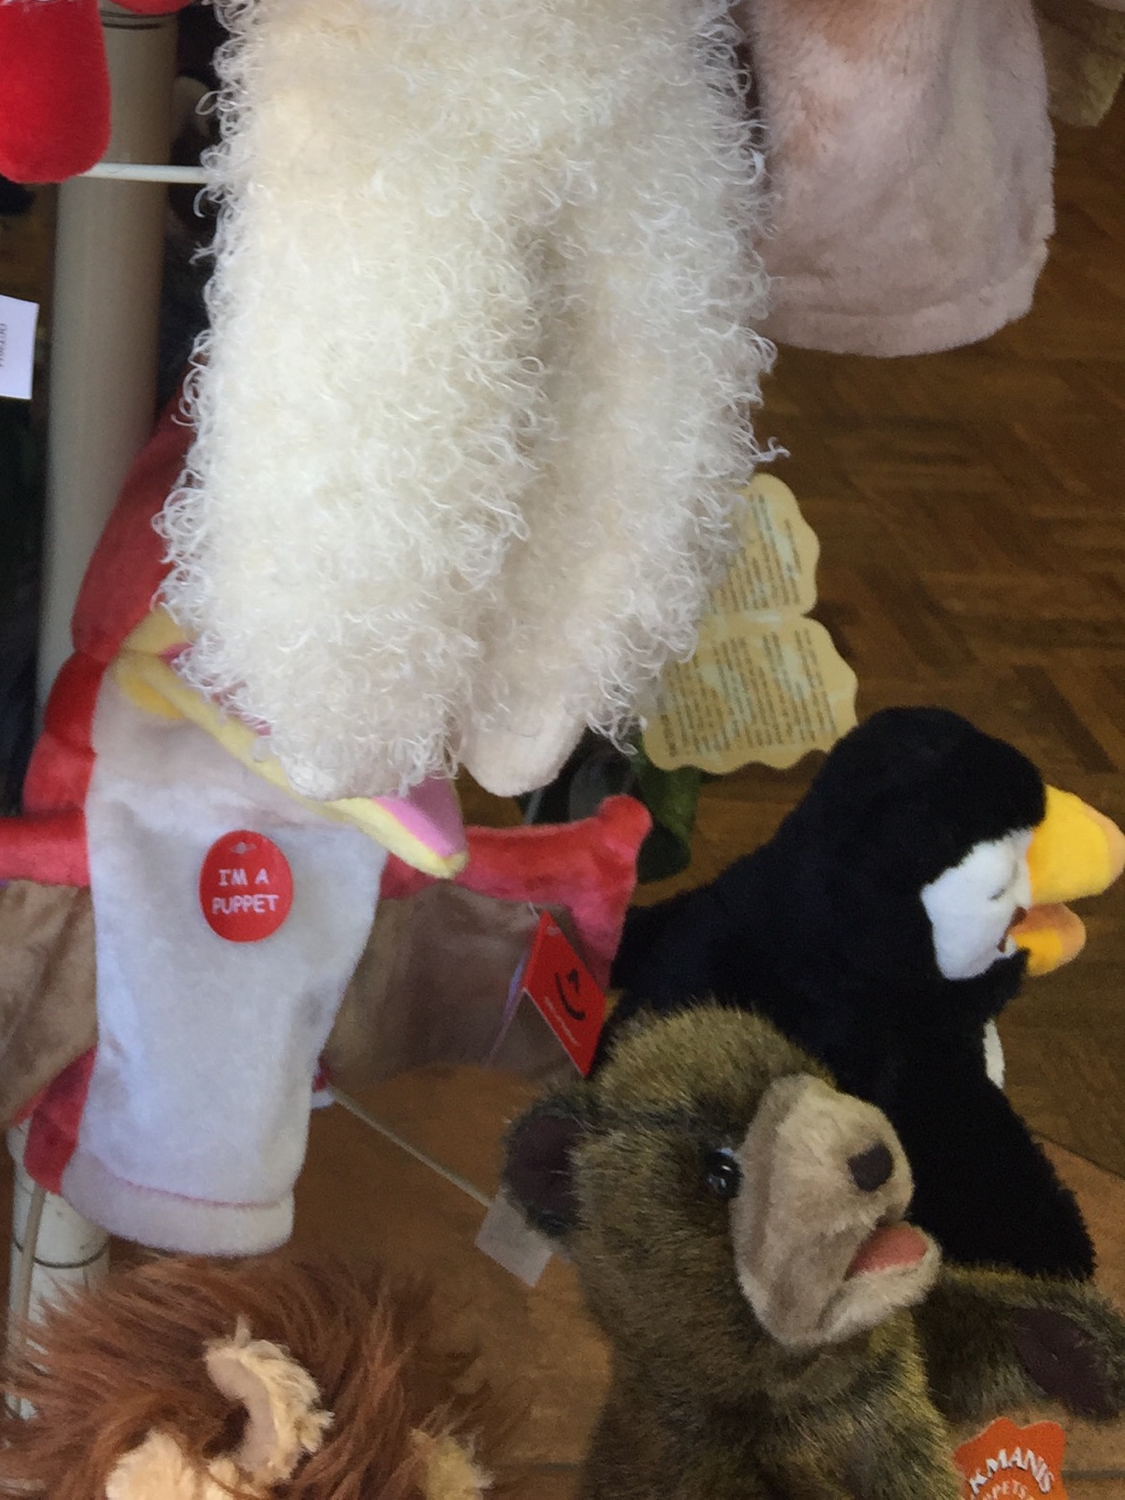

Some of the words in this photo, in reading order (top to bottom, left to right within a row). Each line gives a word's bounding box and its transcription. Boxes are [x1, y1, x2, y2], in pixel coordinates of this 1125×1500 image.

[218, 868, 248, 886] I'M
[254, 868, 269, 885] A
[212, 894, 279, 915] PUPPET
